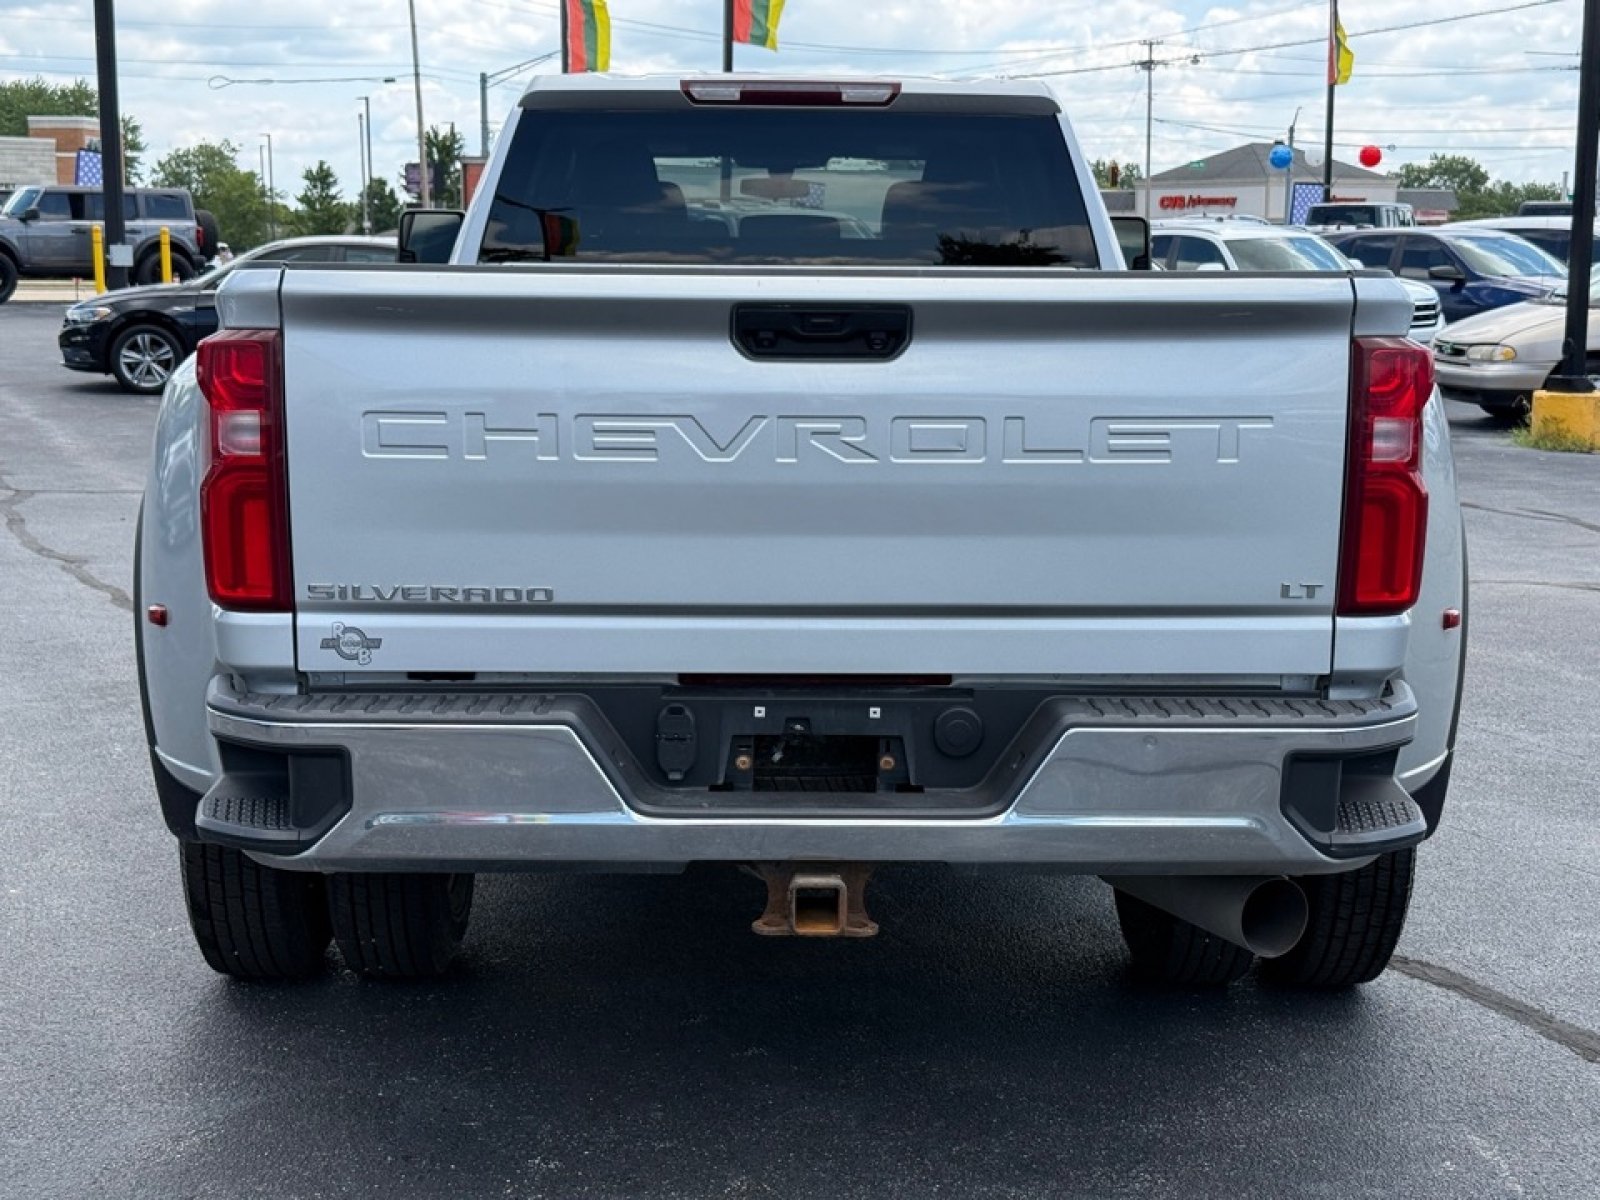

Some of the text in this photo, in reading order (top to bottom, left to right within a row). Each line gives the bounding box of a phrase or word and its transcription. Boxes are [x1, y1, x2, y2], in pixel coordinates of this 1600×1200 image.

[361, 410, 1274, 465] CHEVROLET
[307, 583, 554, 601] SILVERADO
[1281, 583, 1324, 599] LT
